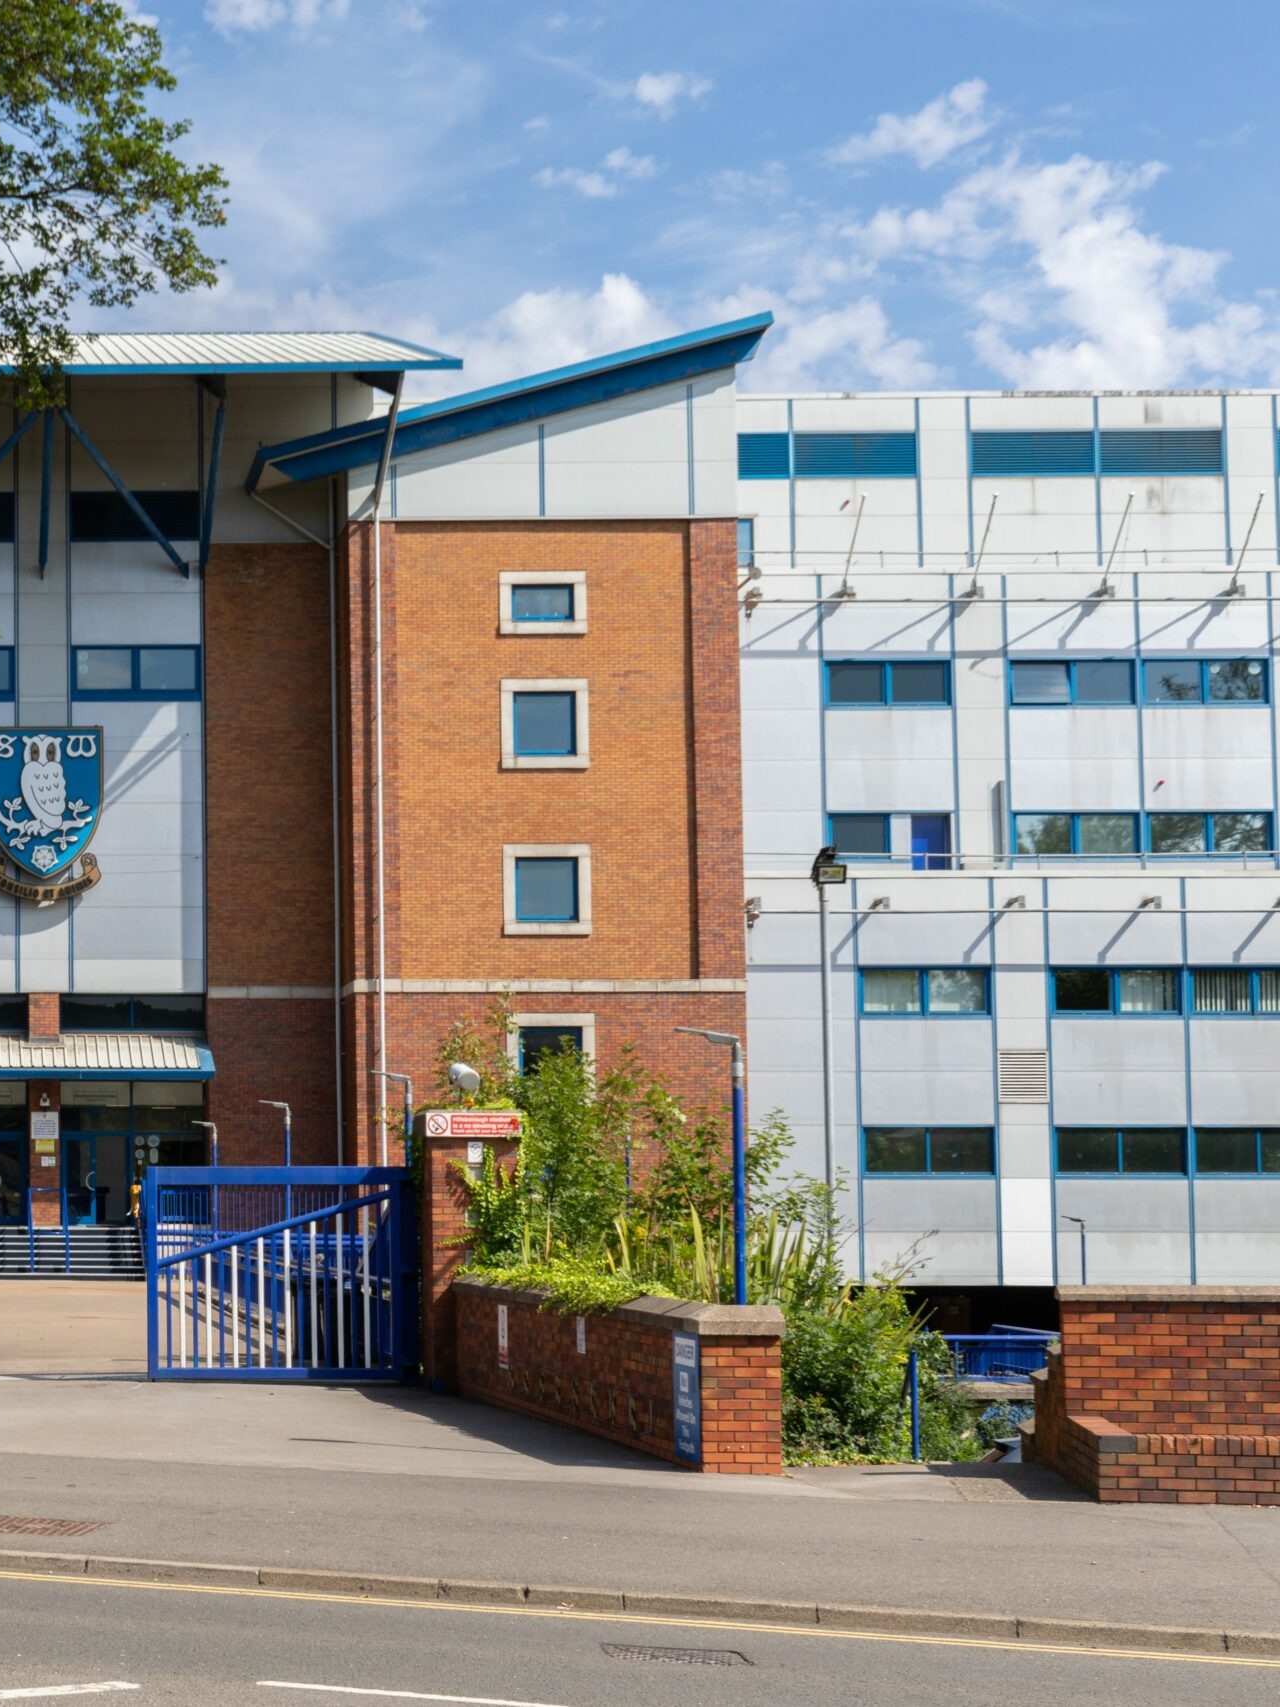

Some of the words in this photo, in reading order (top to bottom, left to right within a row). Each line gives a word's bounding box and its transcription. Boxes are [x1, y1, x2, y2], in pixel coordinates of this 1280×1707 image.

[66, 735, 96, 758] W
[42, 888, 55, 899] ET
[676, 1344, 694, 1360] DANGER
